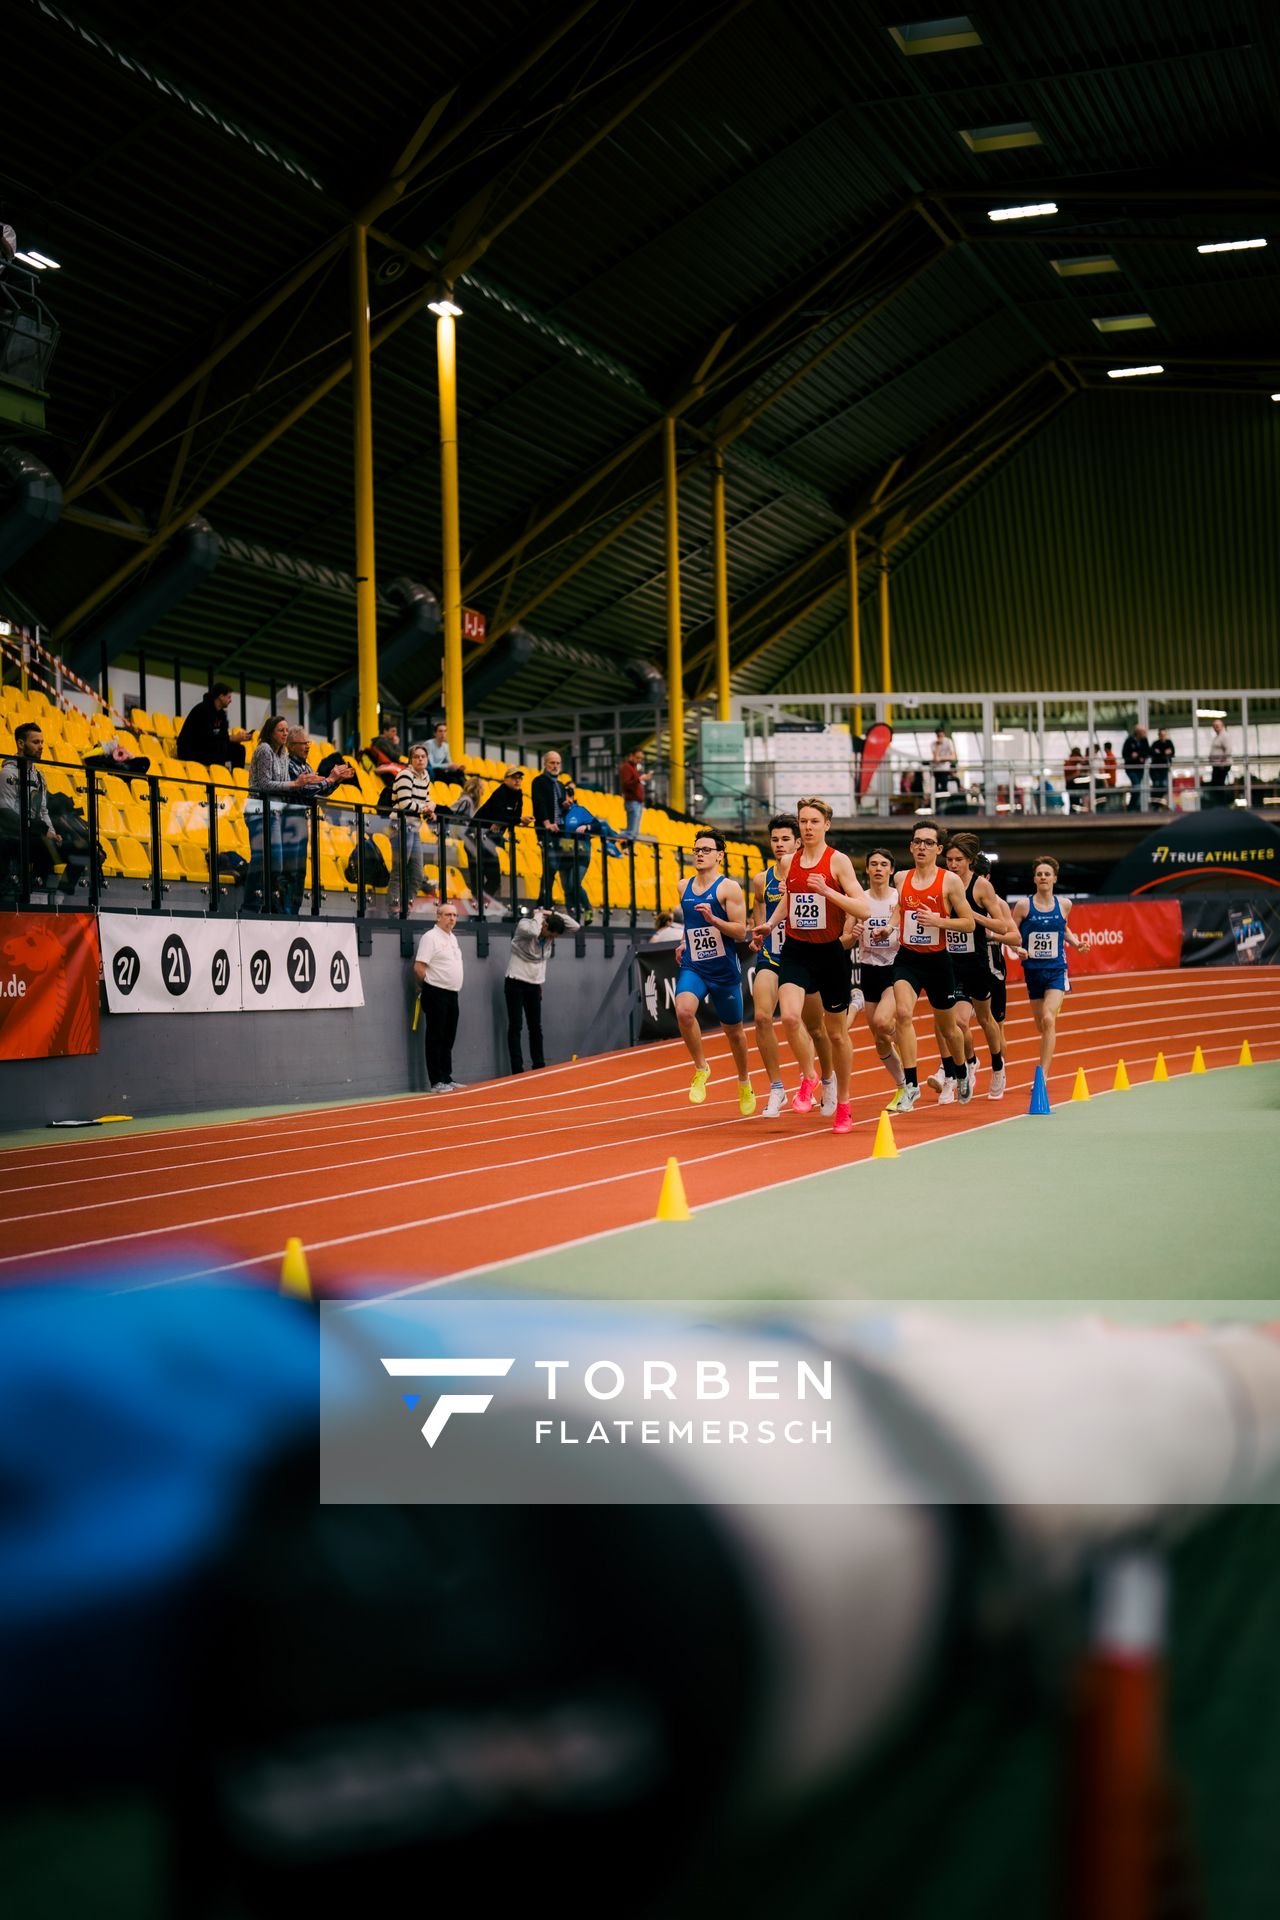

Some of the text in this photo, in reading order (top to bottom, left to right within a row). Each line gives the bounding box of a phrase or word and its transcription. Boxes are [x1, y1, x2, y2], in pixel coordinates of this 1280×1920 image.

[795, 894, 814, 903] GLS
[794, 904, 819, 918] 428
[869, 919, 887, 927] GLS
[693, 928, 710, 938] GLS
[946, 931, 968, 944] 550
[693, 936, 717, 951] 246
[1033, 940, 1052, 951] 291
[117, 956, 135, 986] 21
[167, 946, 186, 984] 21
[214, 958, 227, 987] 21
[253, 948, 346, 987] 21 21 21
